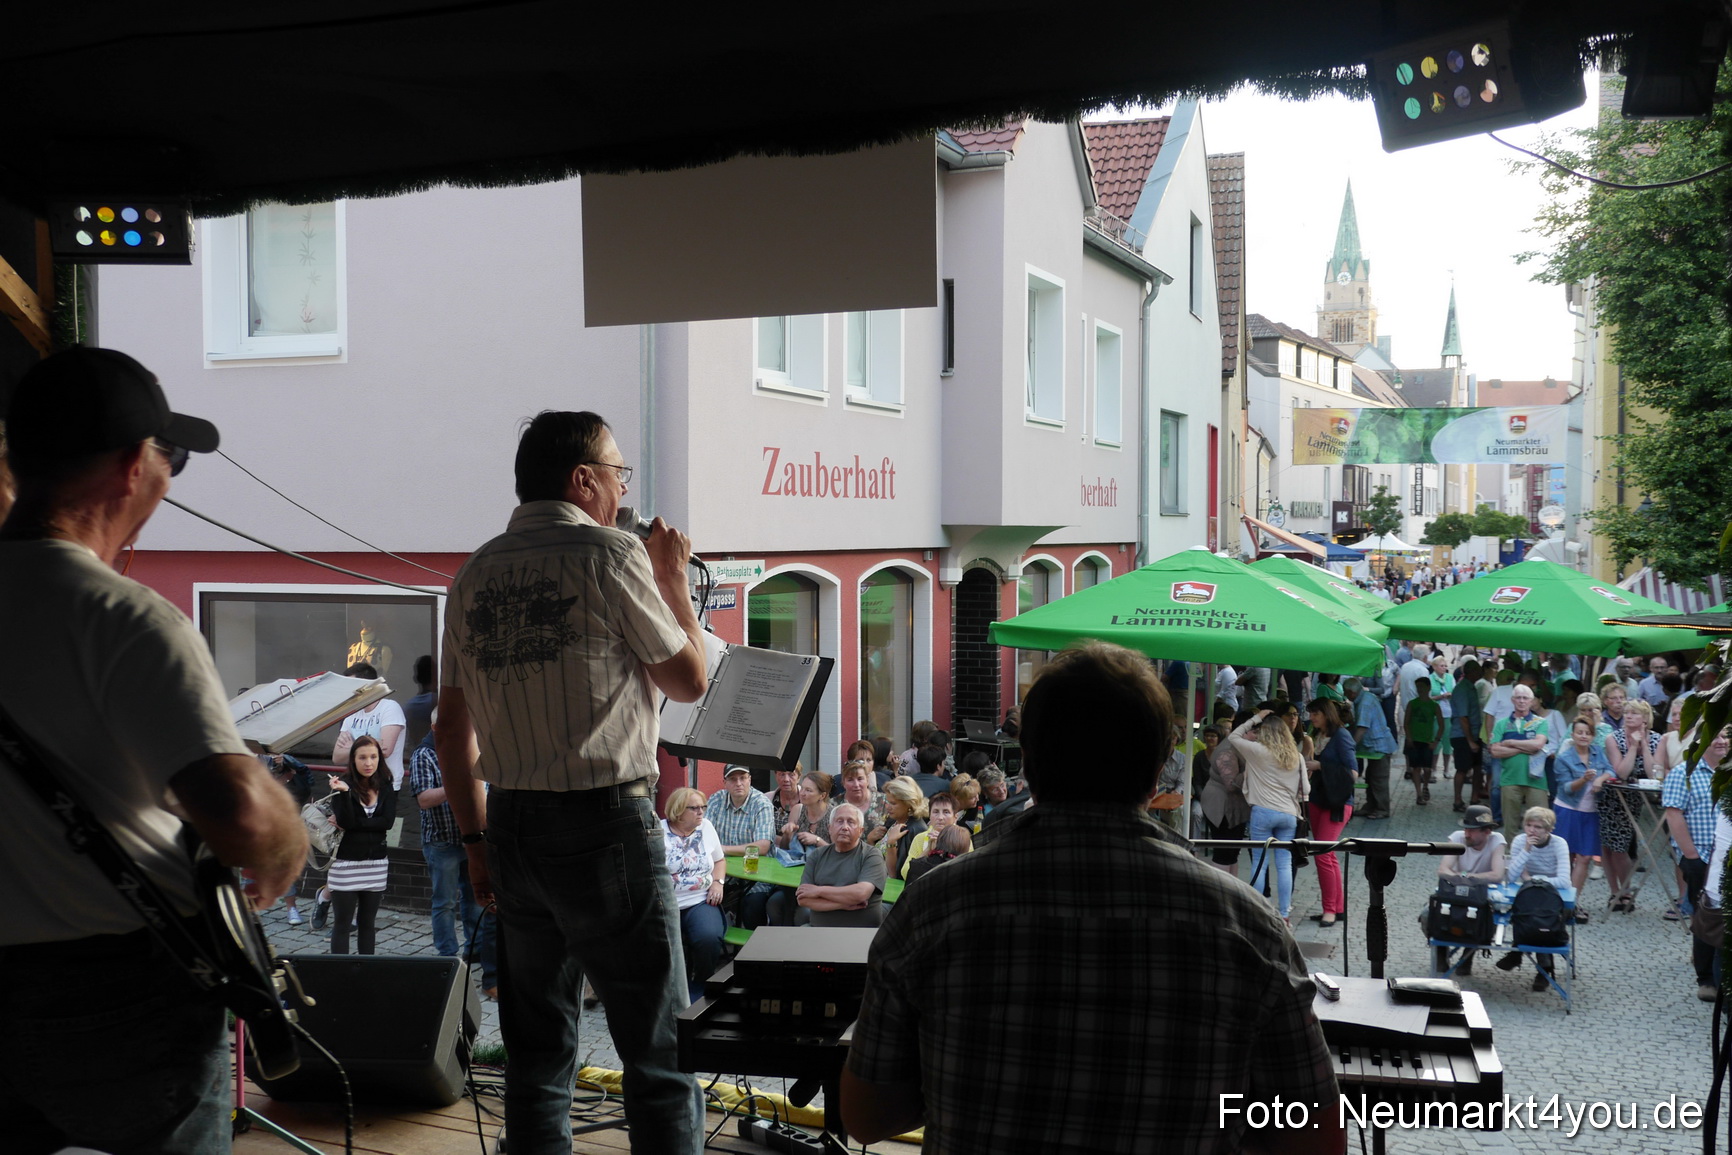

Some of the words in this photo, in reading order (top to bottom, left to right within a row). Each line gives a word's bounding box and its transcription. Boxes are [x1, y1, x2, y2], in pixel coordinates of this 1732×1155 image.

[1486, 446, 1548, 456] Lammsbräu
[761, 446, 896, 500] Zauberhaft
[1081, 475, 1117, 507] berhaft
[1336, 511, 1348, 523] K
[717, 565, 752, 579] Rathausplatz
[1134, 607, 1248, 620] Neumarkter
[1457, 607, 1539, 616] Neumarkter
[1110, 615, 1267, 632] Lammsbräu
[1435, 613, 1547, 626] Lammsbräu
[801, 657, 813, 665] 33
